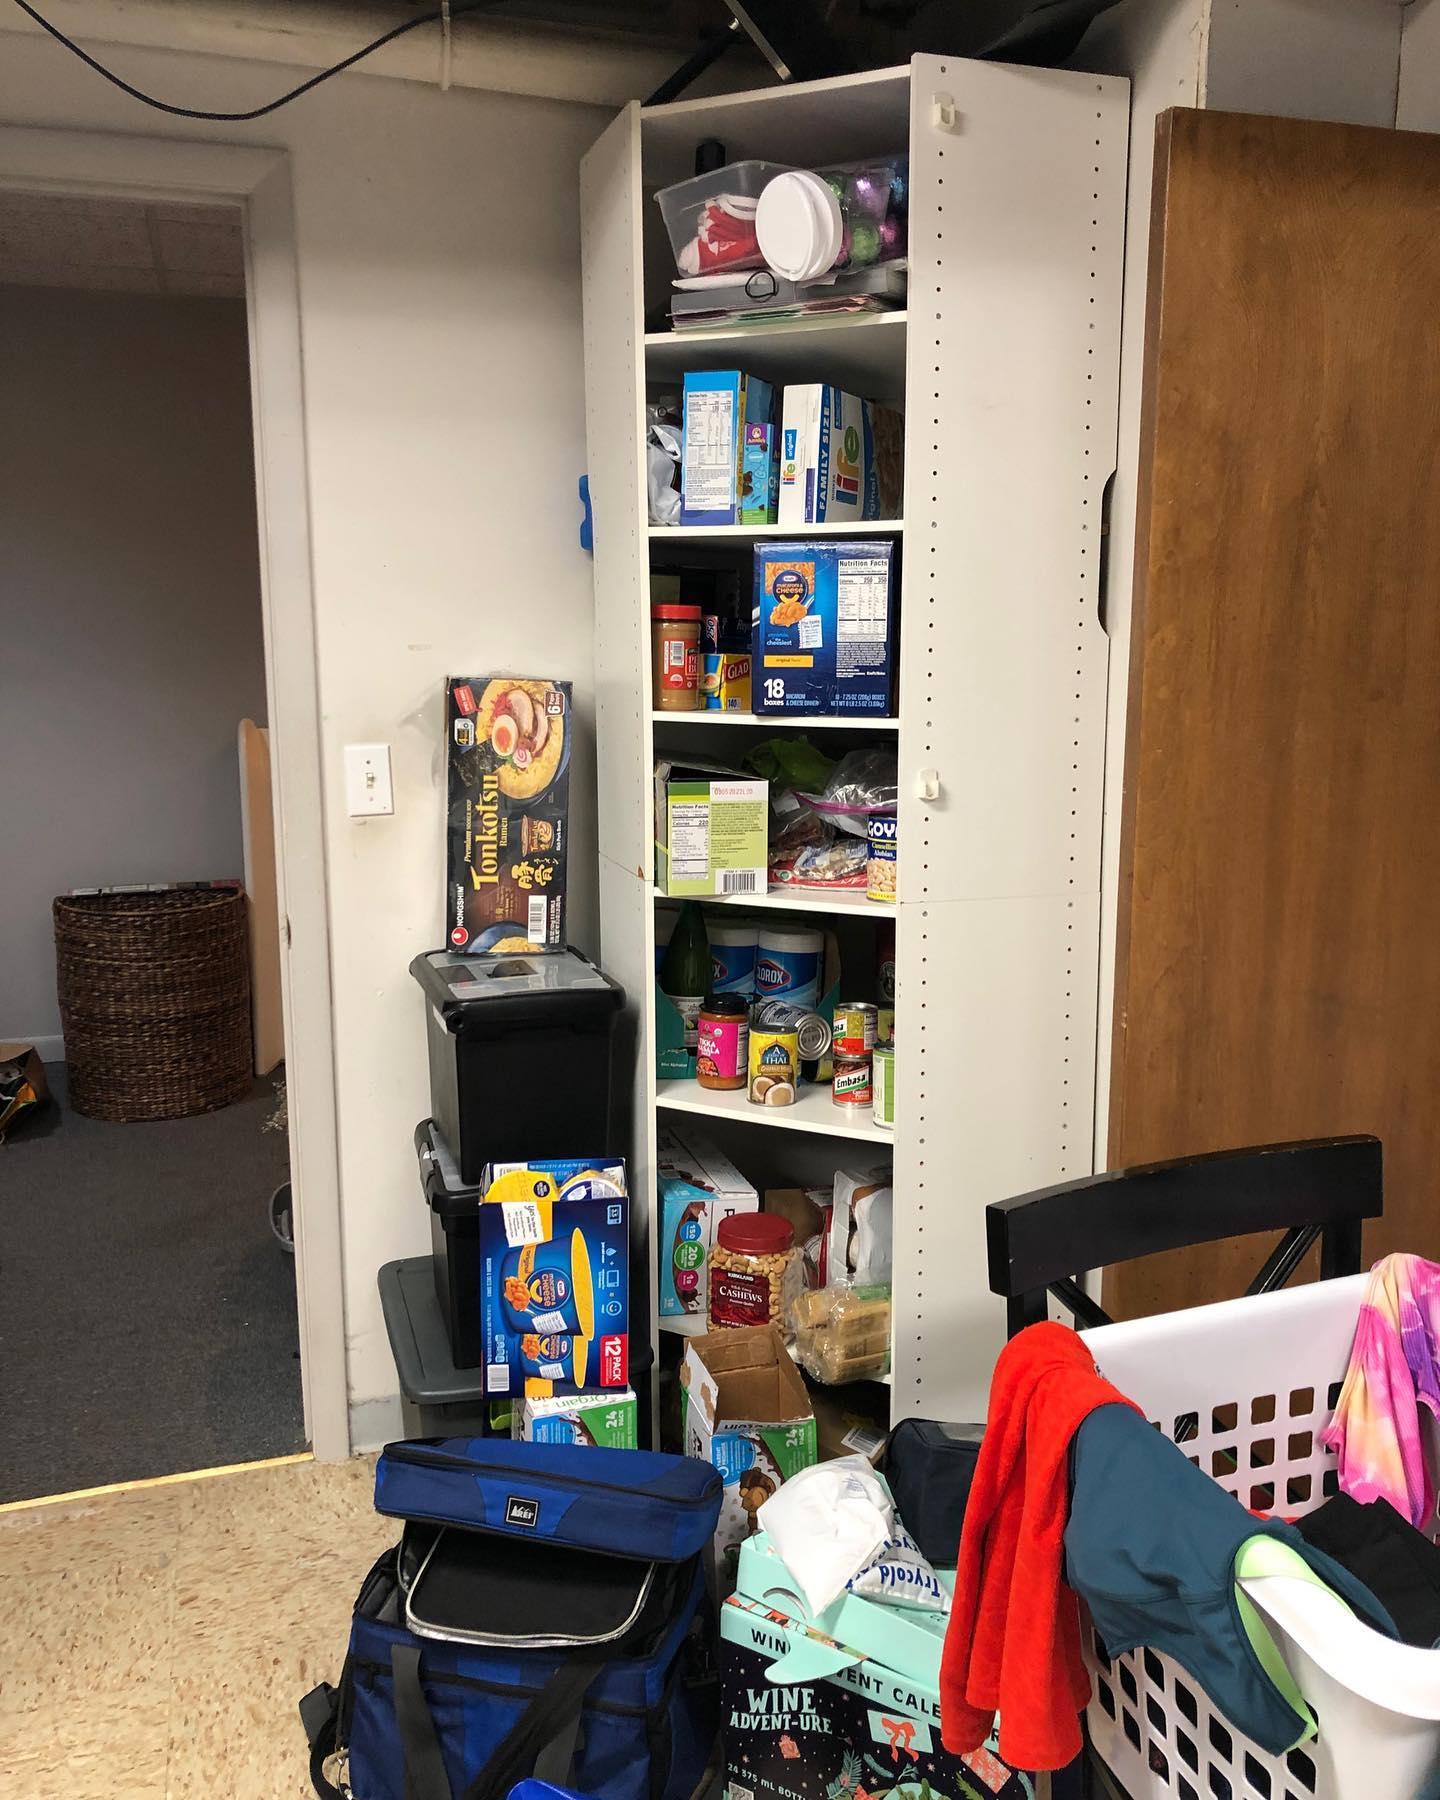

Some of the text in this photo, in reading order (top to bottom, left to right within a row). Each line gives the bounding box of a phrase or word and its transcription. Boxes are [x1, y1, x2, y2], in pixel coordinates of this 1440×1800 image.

[819, 407, 830, 510] FAMILY SIZE
[836, 426, 860, 505] life
[782, 463, 796, 485] life
[727, 662, 749, 680] GLAD
[764, 678, 785, 699] 18
[547, 705, 561, 714] 6
[763, 698, 785, 706] boxes
[470, 775, 499, 891] Tonkotsu
[499, 817, 508, 847] Ramen
[868, 821, 897, 838] GOY
[456, 886, 464, 927] NONGSHIM
[757, 966, 784, 985] LOROX
[766, 1056, 787, 1065] THAI
[773, 1046, 780, 1054] A
[837, 1074, 866, 1089] Embasa
[523, 1250, 532, 1274] original
[687, 1246, 698, 1266] 20g
[727, 1272, 754, 1282] KIRKLAND
[719, 1285, 763, 1303] CASHEWS
[604, 1337, 622, 1357] 12
[612, 1356, 622, 1381] PACK
[878, 1565, 941, 1598] Trycold
[751, 1628, 791, 1654] WIN
[747, 1687, 818, 1715] WINE
[729, 1711, 833, 1735] ADVENT-URE
[727, 1763, 739, 1774] 24
[741, 1768, 758, 1783] 375
[760, 1778, 775, 1791] mL
